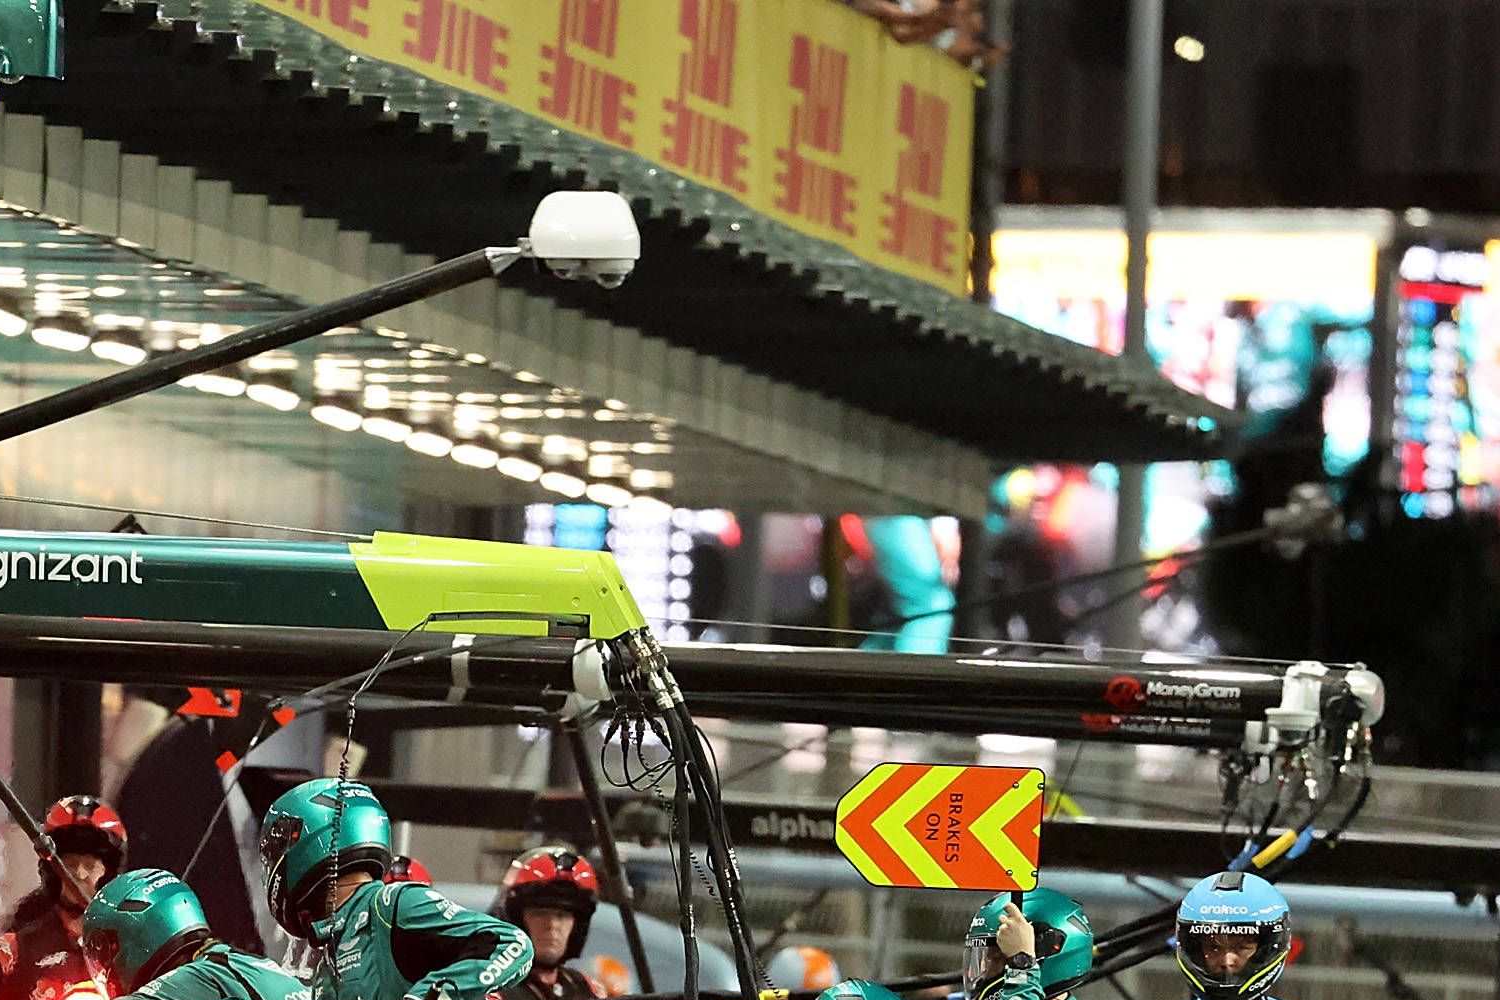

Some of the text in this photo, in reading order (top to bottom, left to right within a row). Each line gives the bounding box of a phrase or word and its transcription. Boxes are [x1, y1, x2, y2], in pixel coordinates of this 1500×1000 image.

[1146, 681, 1241, 700] MoneyGram
[925, 813, 941, 841] ON
[944, 792, 964, 863] BRAKES
[1199, 904, 1248, 915] aramco
[1189, 924, 1260, 935] ASTON MARTIN
